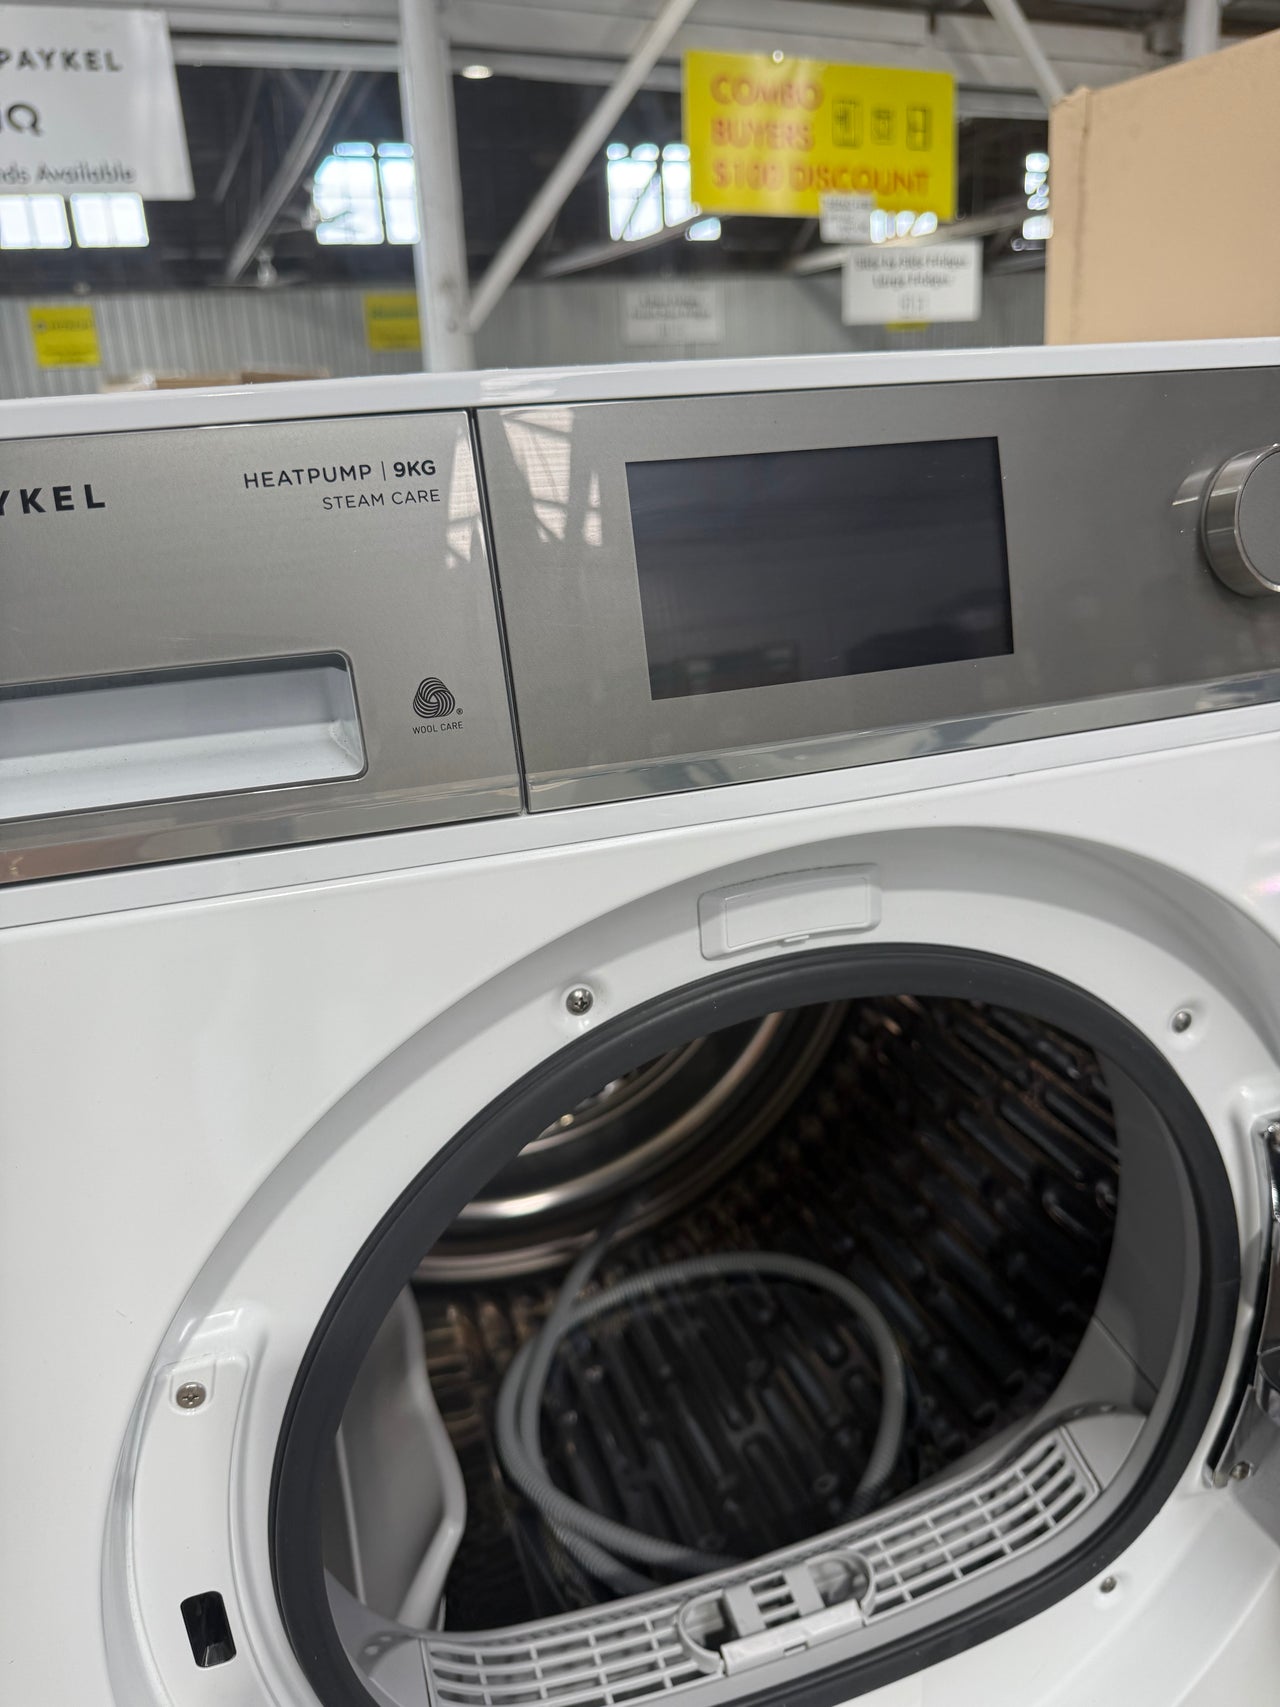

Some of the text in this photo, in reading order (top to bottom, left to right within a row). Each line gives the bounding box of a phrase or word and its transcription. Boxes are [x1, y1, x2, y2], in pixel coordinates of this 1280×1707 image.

[710, 72, 824, 111] COMBO
[711, 115, 815, 152] BUYERS
[35, 159, 137, 185] Available
[789, 162, 930, 195] DISCOUNT
[243, 460, 436, 489] HEATPUMP 9KG
[322, 488, 441, 511] STEAM CARE
[412, 721, 464, 735] WOOL CARE
